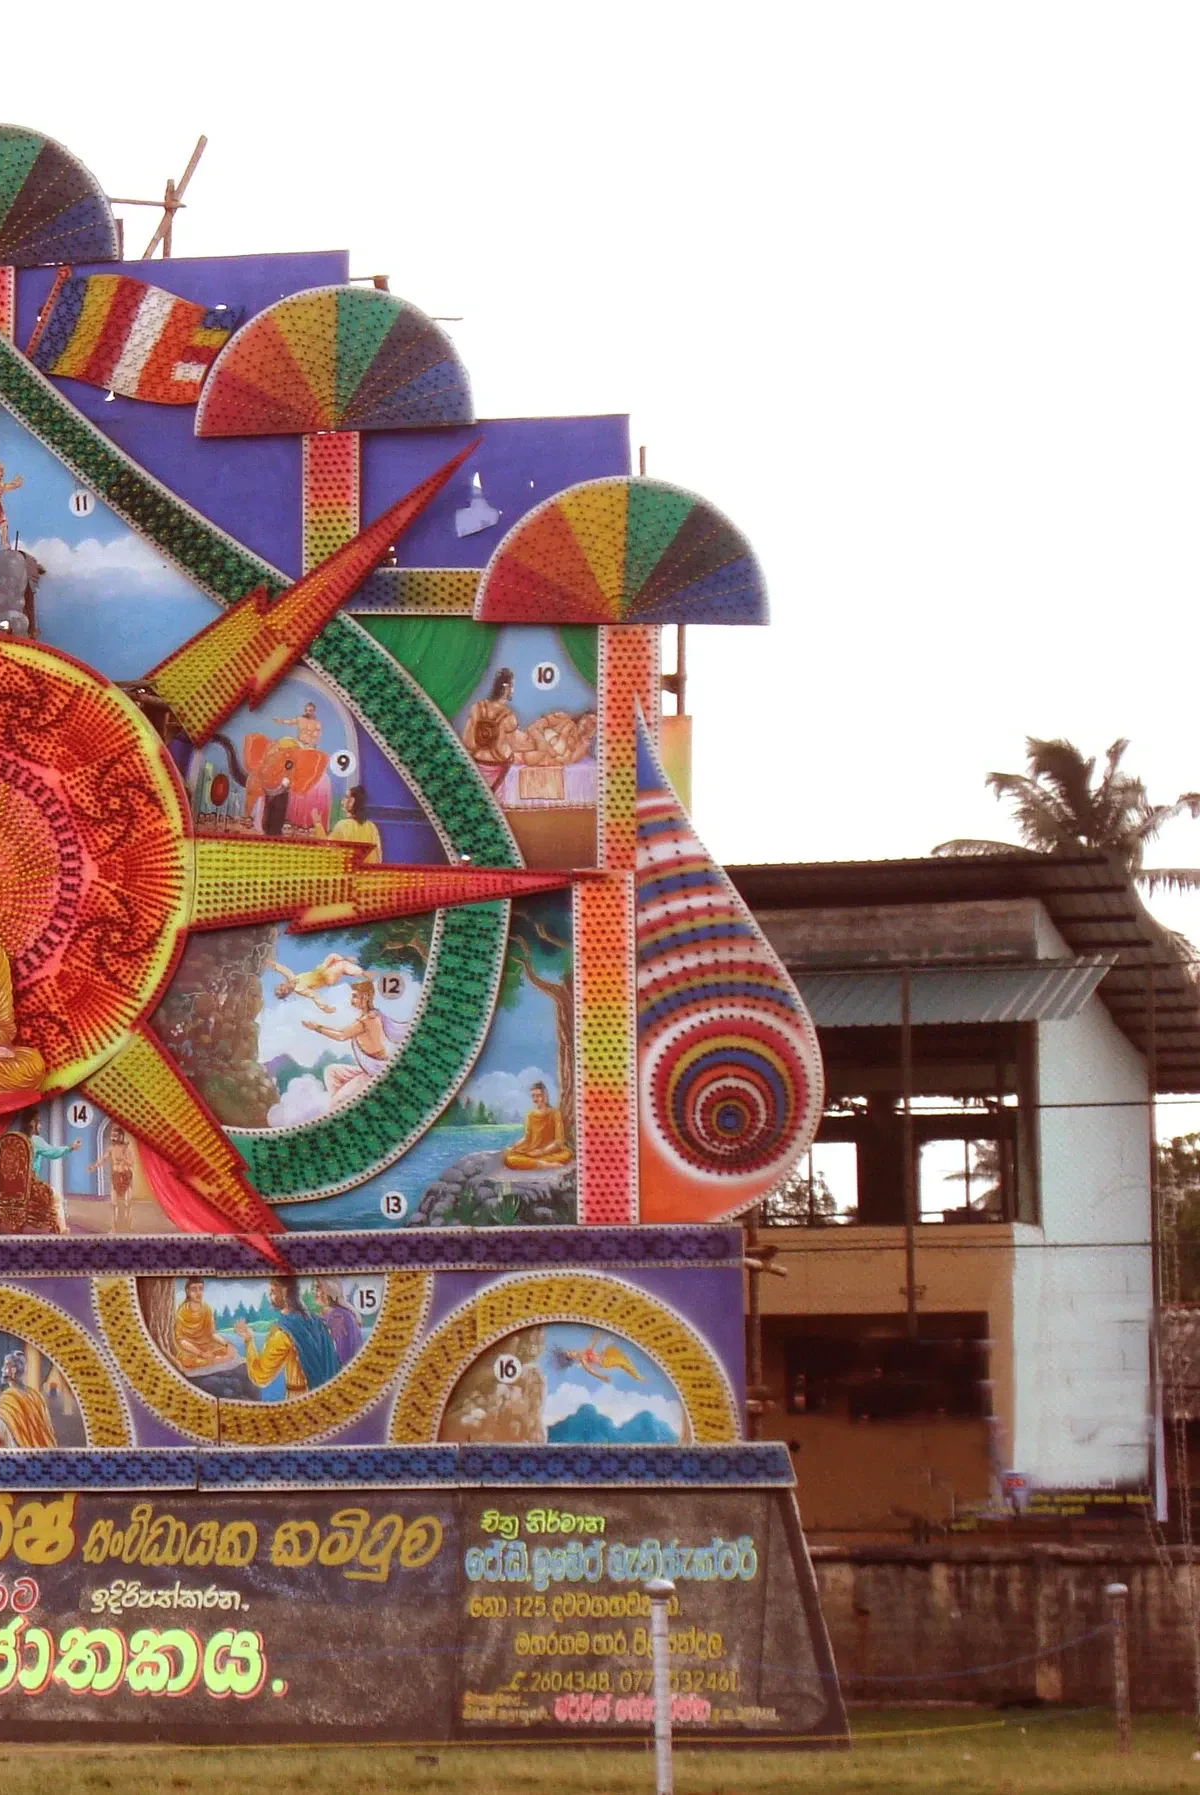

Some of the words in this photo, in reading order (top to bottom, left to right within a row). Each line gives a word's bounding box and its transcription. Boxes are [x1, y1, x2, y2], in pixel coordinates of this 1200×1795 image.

[75, 495, 88, 512] 11
[537, 666, 555, 683] 10
[336, 754, 350, 772] 9
[382, 977, 400, 994] 12
[72, 1105, 88, 1123] 14
[385, 1197, 402, 1215] 13
[360, 1289, 376, 1308] 15
[499, 1359, 517, 1378] 16
